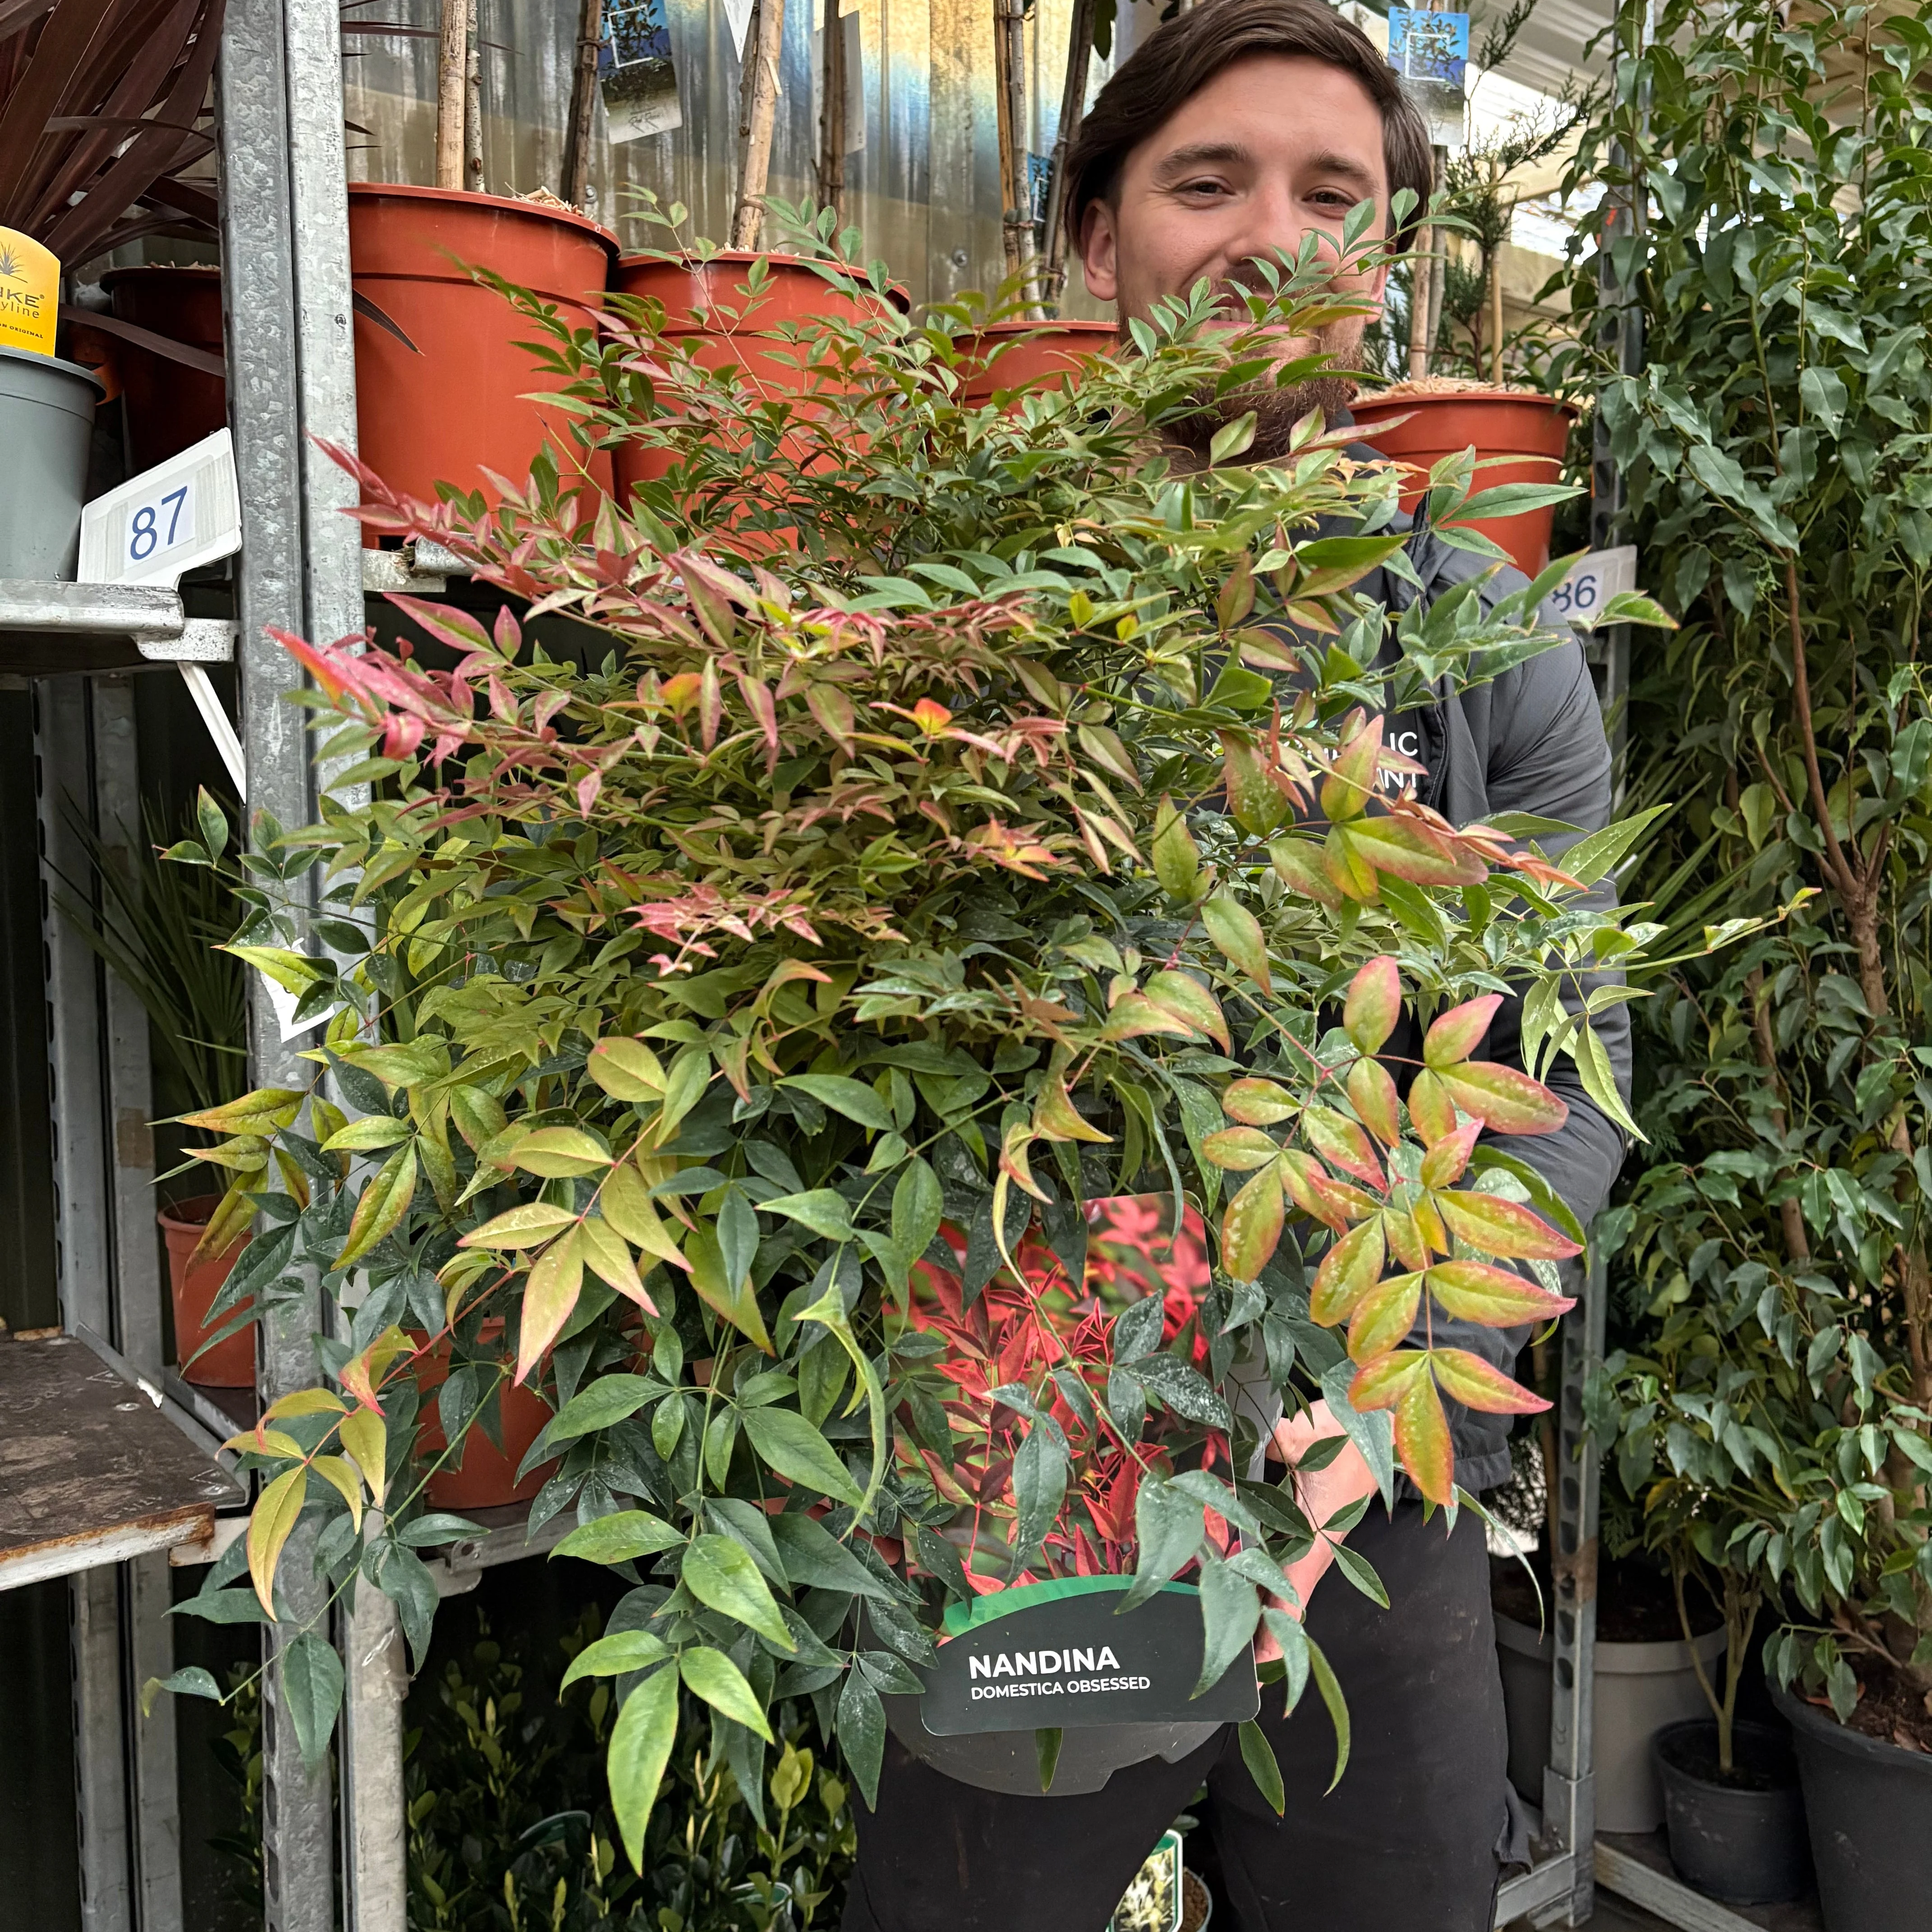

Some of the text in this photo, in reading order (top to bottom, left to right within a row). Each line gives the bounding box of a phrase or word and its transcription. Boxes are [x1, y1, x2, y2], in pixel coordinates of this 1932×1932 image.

[0, 301, 40, 318] yline
[9, 325, 43, 339] ORIGINAL
[130, 485, 188, 560] 87
[969, 1646, 1121, 1679] NANDINA
[971, 1676, 1150, 1700] DOMESTICA OBSESSED
